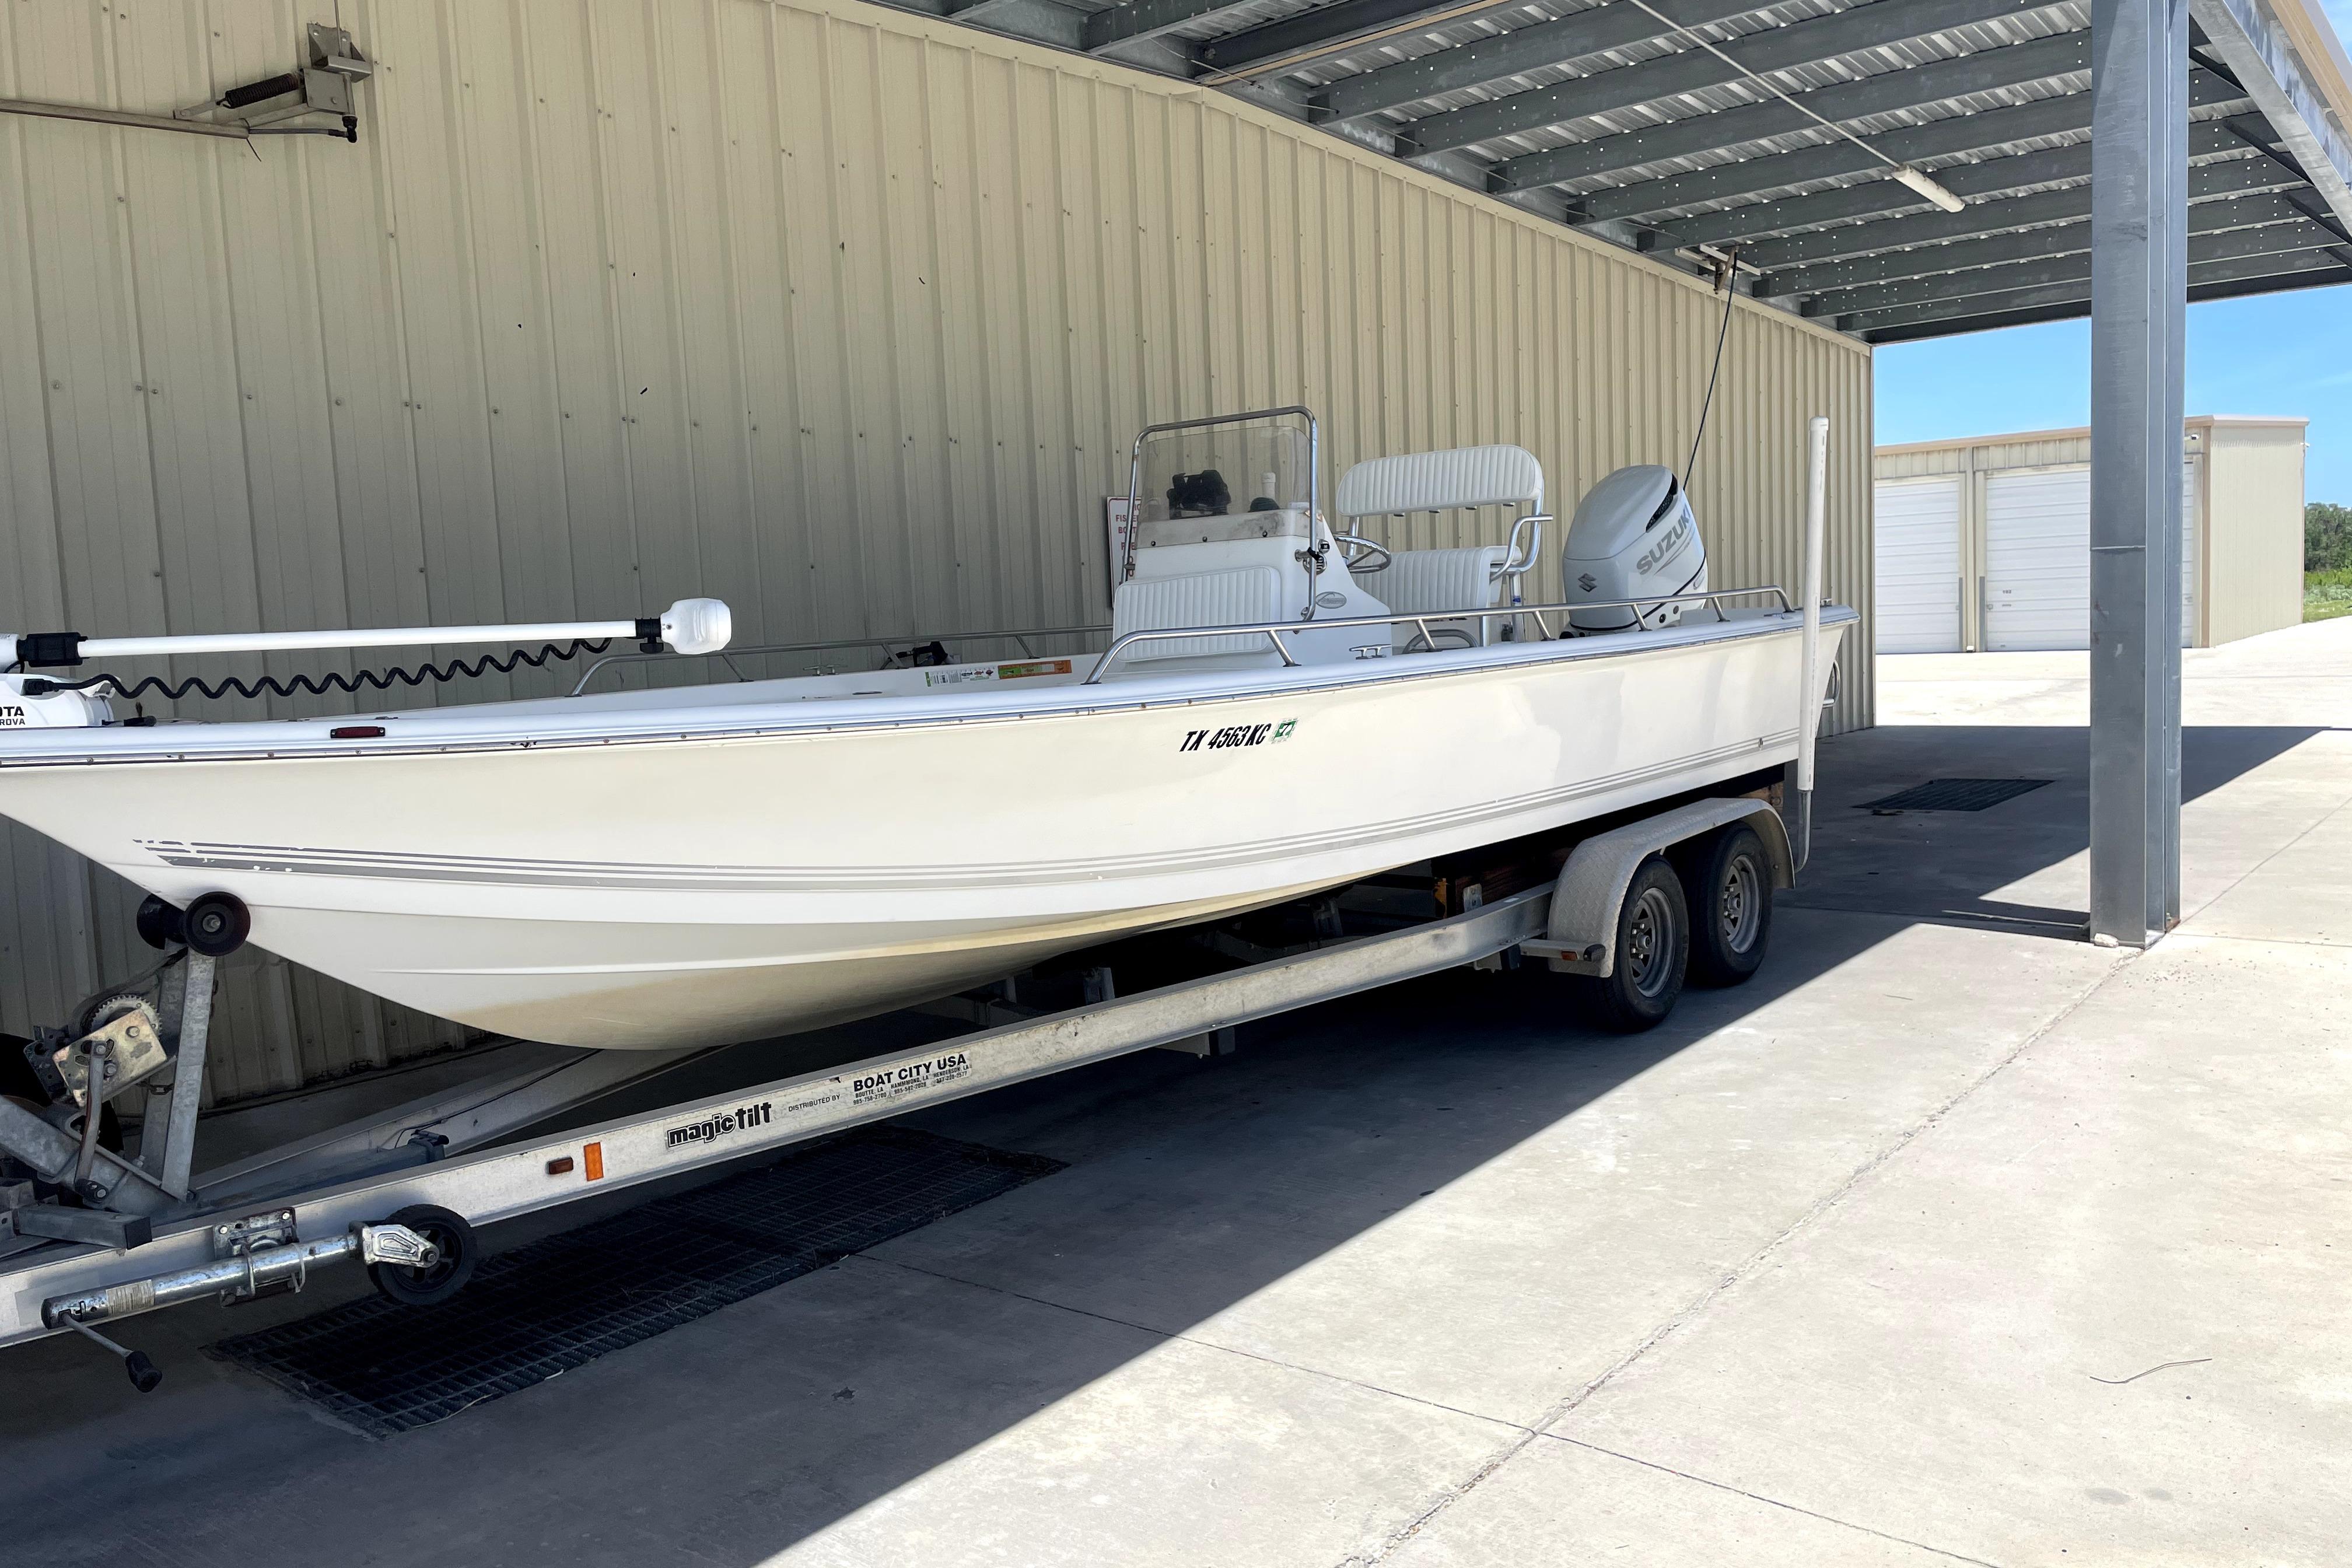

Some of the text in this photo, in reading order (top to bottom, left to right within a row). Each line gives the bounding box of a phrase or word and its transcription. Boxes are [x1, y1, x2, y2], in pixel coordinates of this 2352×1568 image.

[1636, 504, 1691, 575] SUZUKI
[0, 706, 24, 716] TA
[1179, 729, 1210, 752] TX
[853, 1054, 967, 1092] BOAT CITY USA
[789, 1097, 831, 1112] DISTRIBUTED
